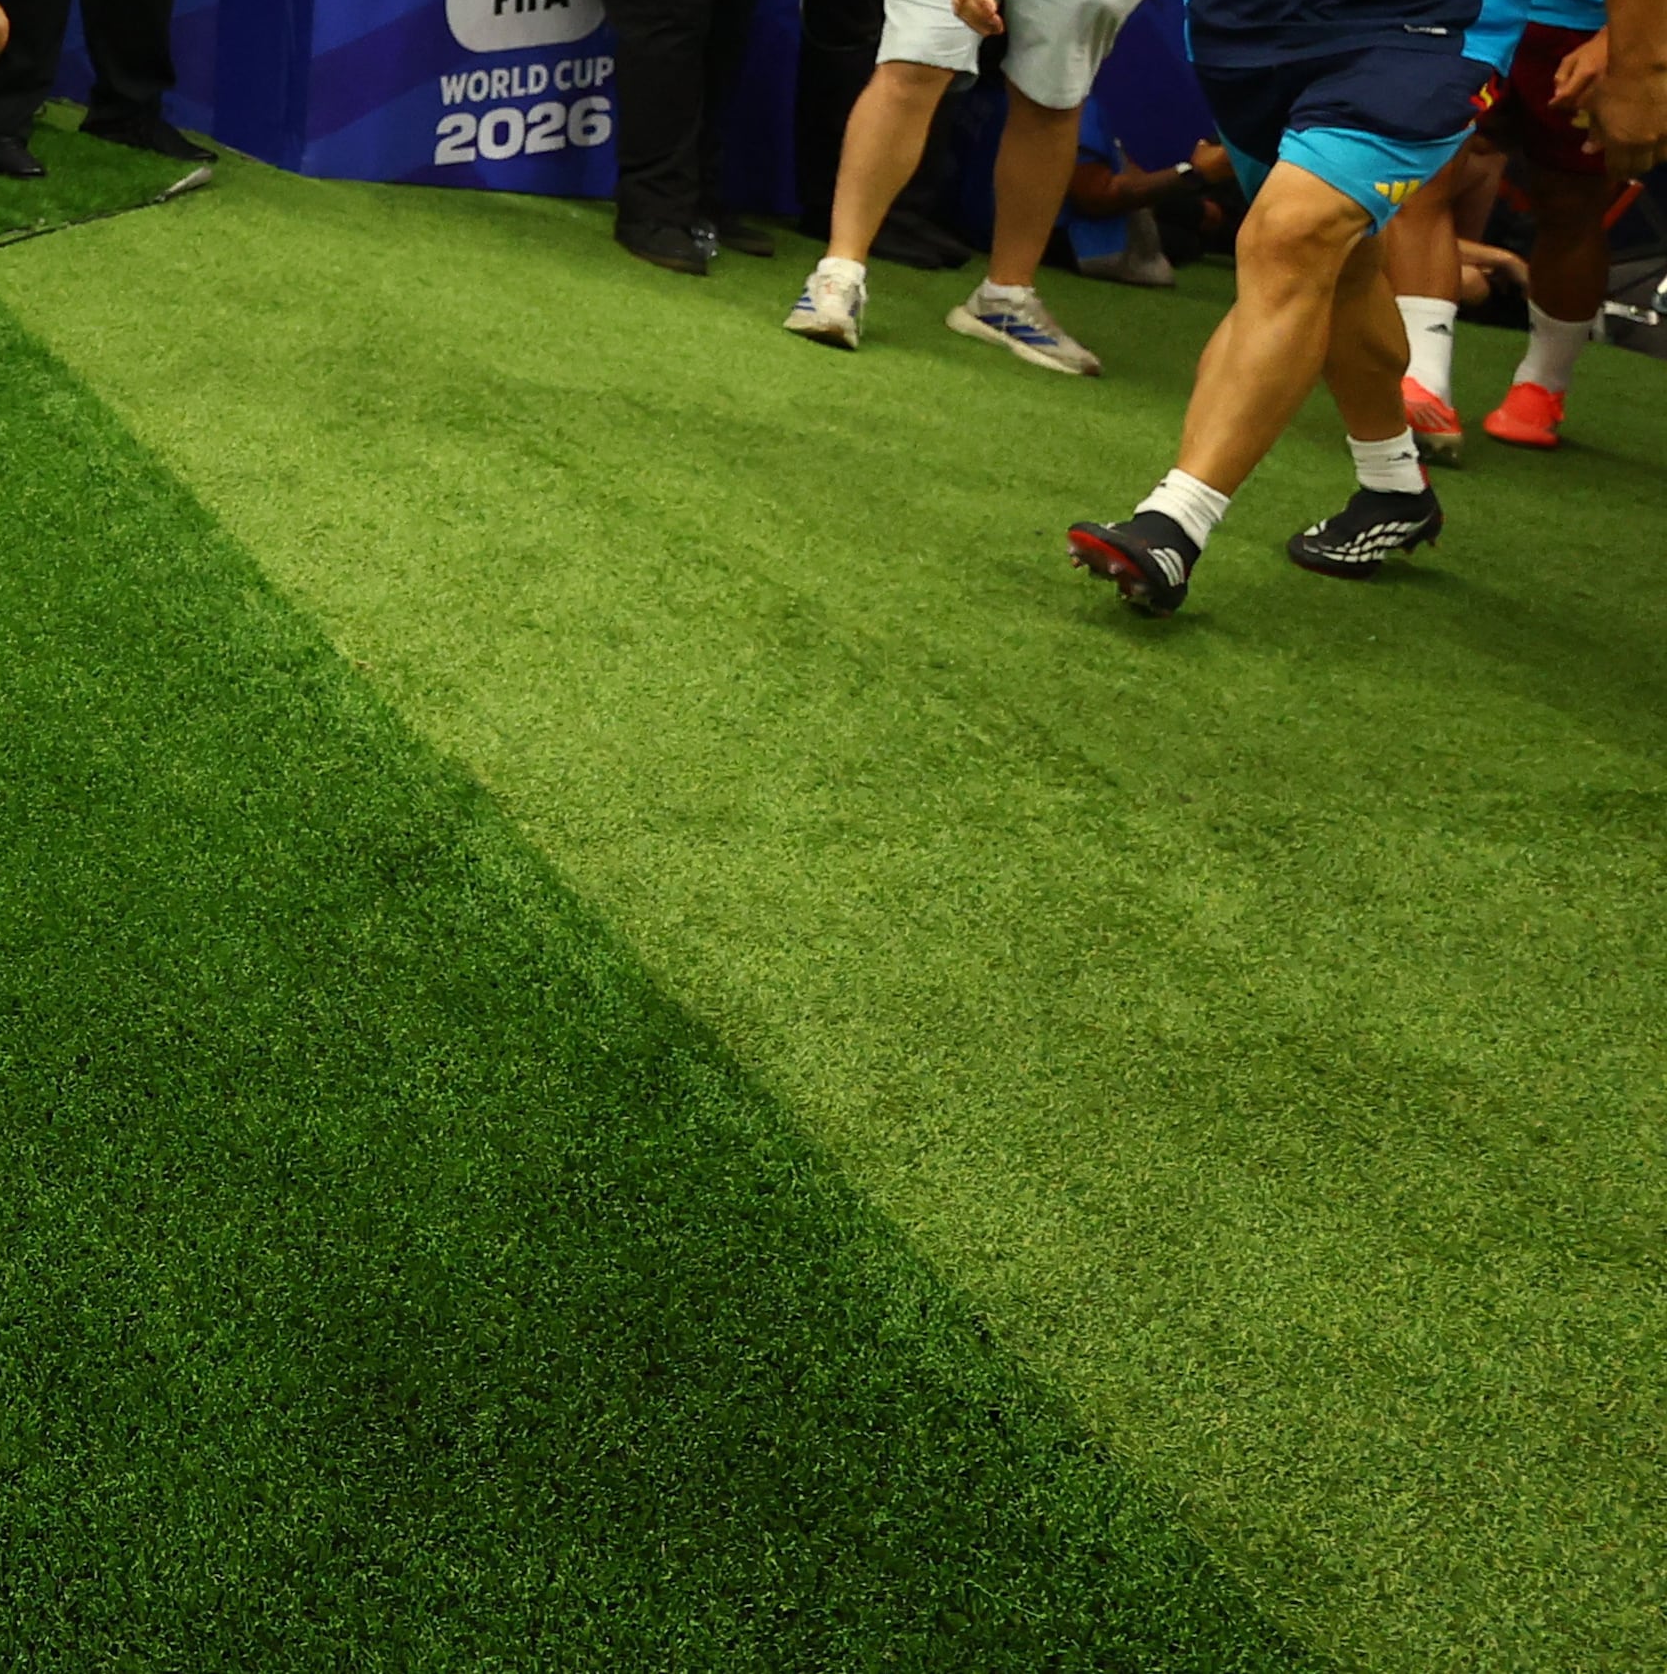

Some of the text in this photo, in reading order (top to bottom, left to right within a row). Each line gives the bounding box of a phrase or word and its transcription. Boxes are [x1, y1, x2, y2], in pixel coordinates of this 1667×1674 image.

[440, 55, 616, 105] WORLD CUP
[434, 95, 613, 164] 2026
